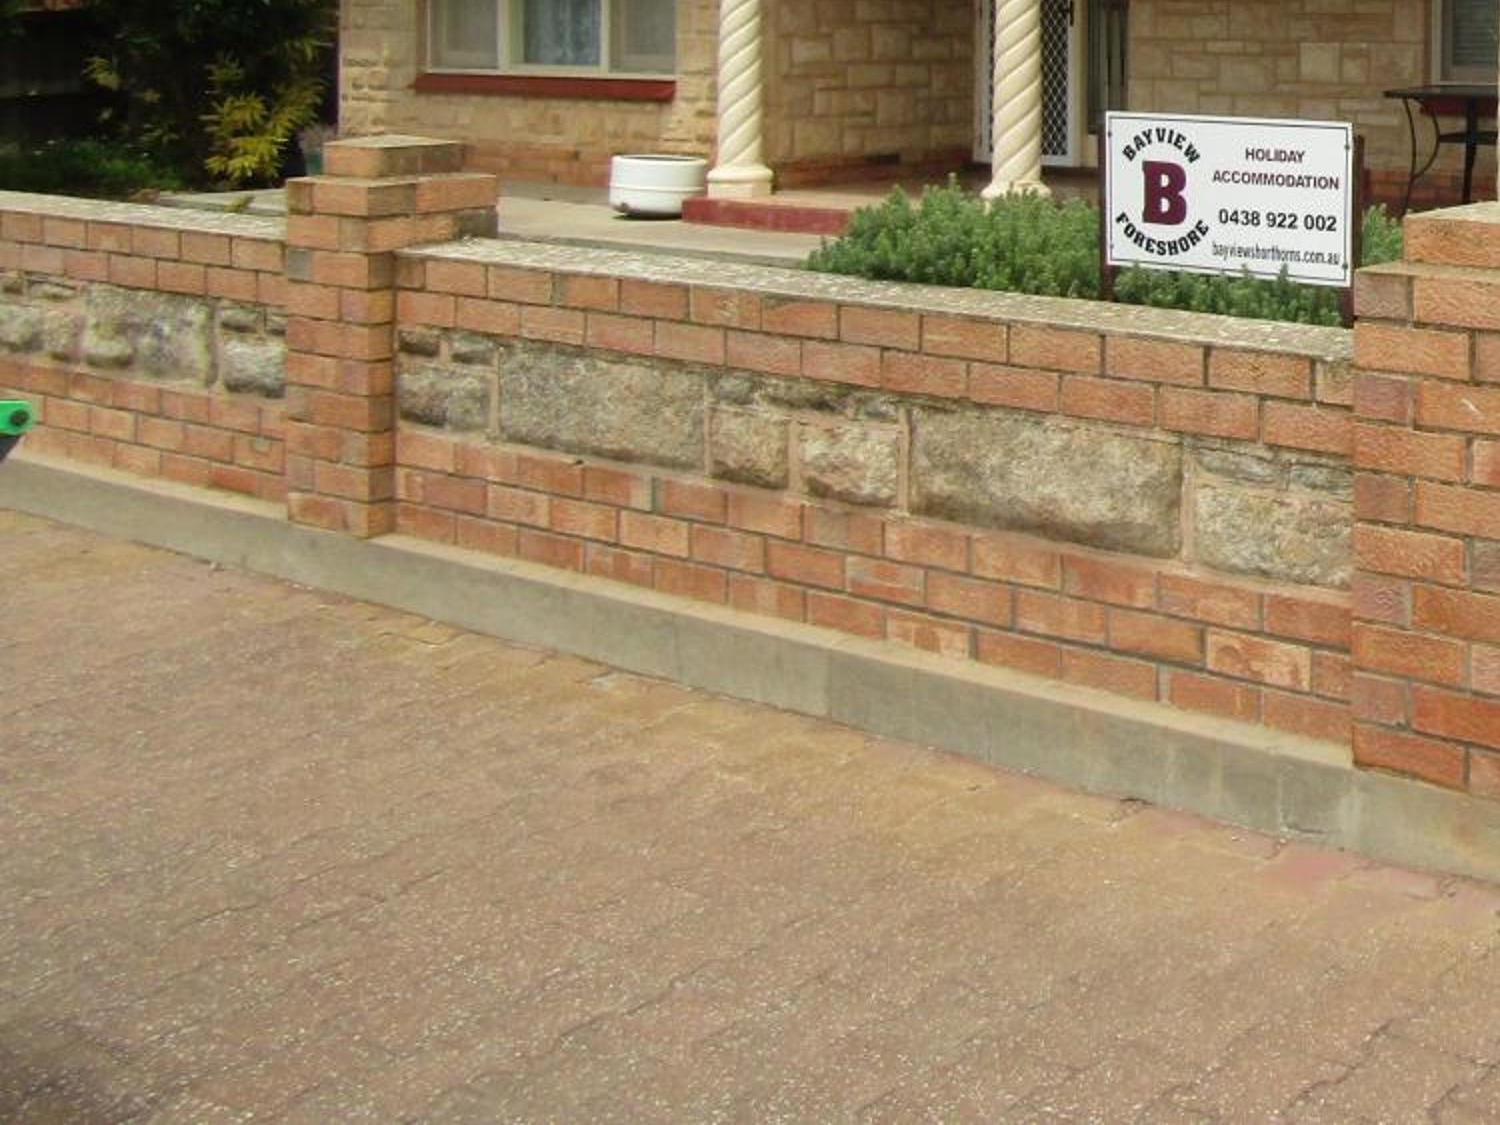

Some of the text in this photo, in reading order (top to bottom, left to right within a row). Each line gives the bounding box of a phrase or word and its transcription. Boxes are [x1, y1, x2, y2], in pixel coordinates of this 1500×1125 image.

[1122, 128, 1200, 163] BAYVIEW
[1245, 148, 1305, 163] HOLIDAY
[1142, 160, 1187, 225] B
[1213, 170, 1339, 190] ACCOMMODATION
[1116, 212, 1209, 256] FORESHORE
[1219, 209, 1337, 232] 0438 922 002
